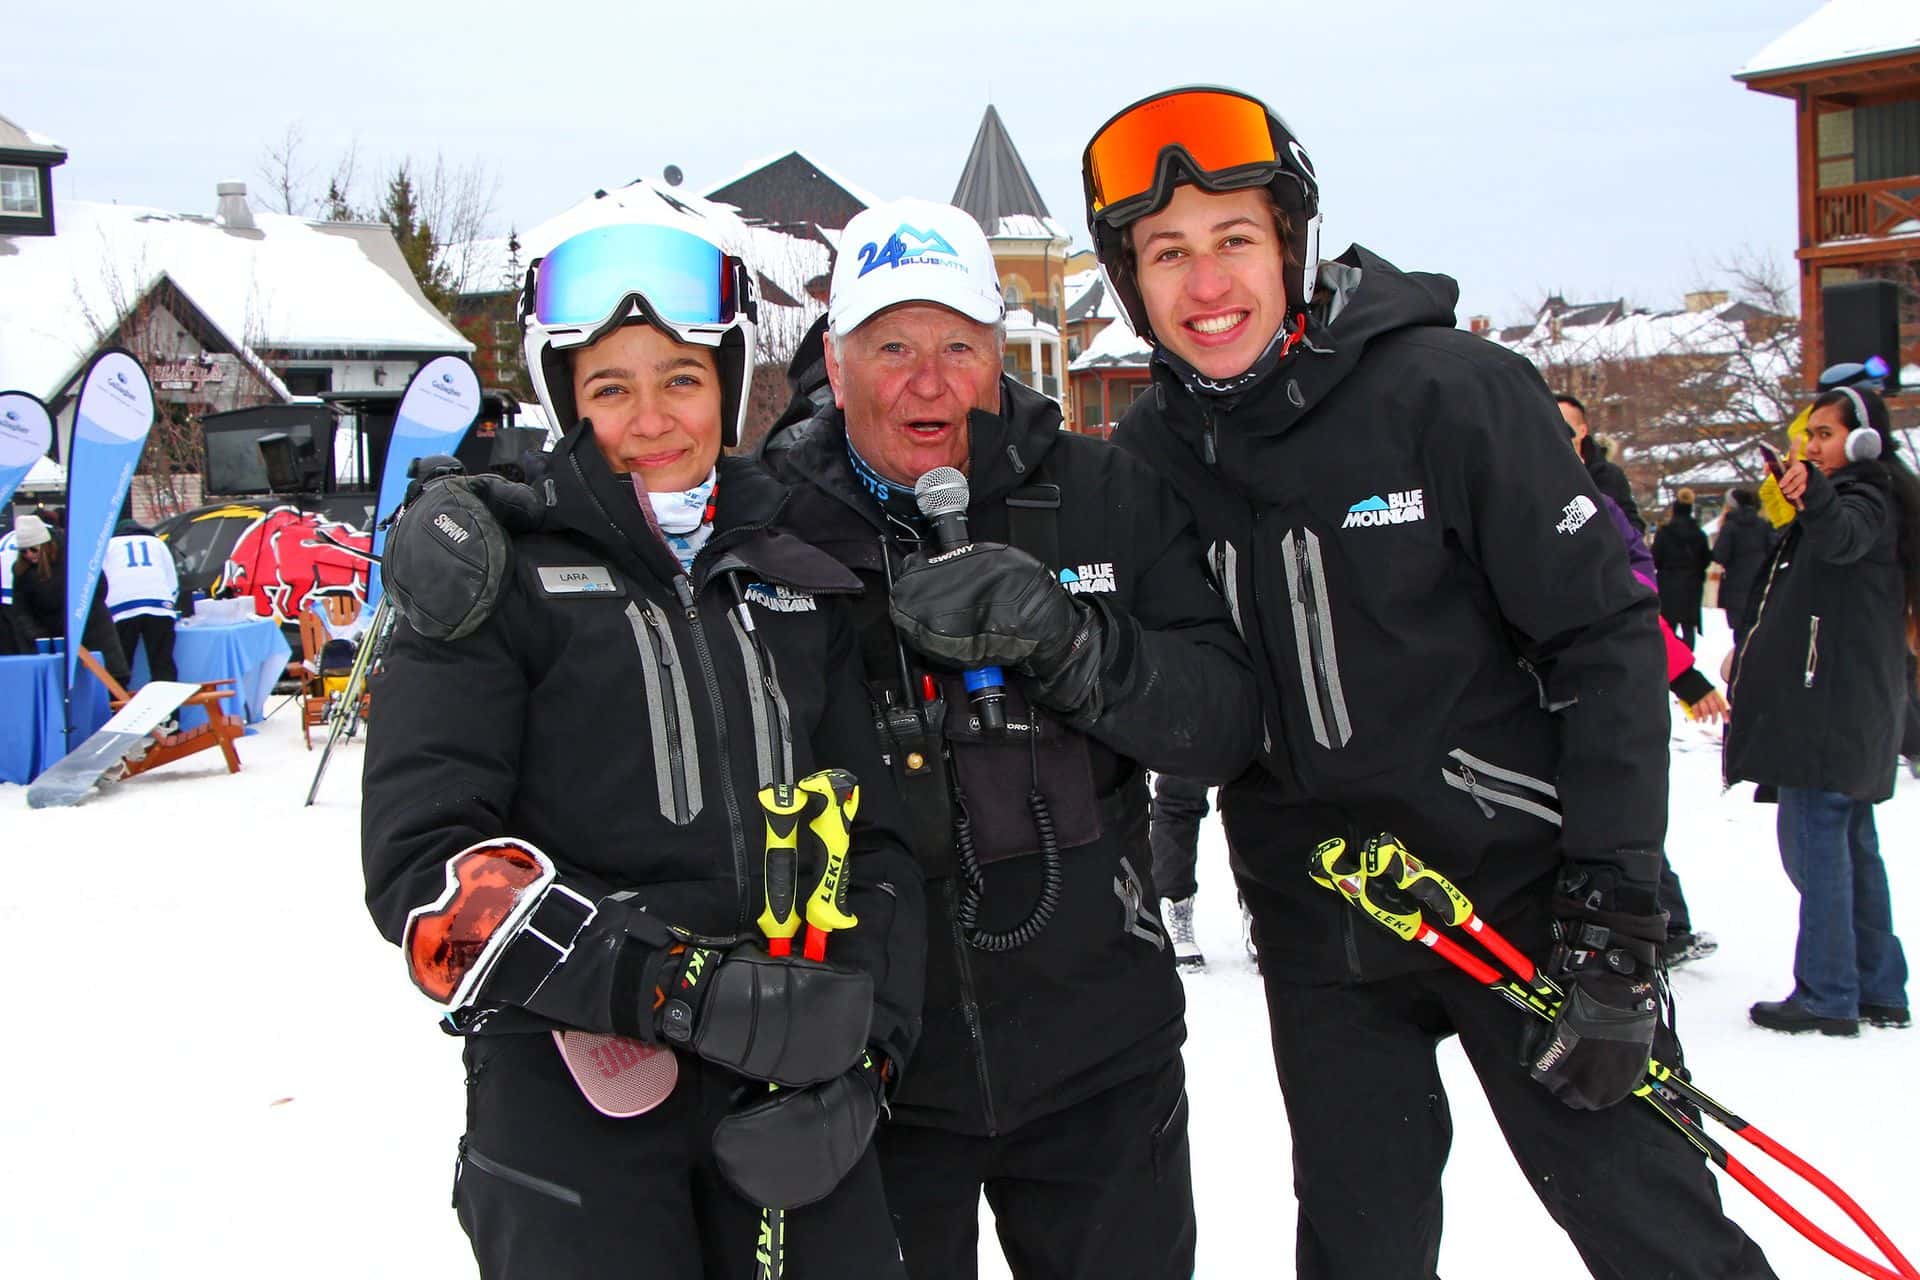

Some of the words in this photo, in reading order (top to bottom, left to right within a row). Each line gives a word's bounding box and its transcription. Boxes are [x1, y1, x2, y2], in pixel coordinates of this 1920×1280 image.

[1387, 489, 1423, 509] BLUE
[433, 513, 470, 544] SWANY
[1340, 504, 1425, 529] MOUNTAIN
[124, 540, 153, 567] 11
[928, 543, 976, 564] SWANY
[560, 573, 590, 582] LARA
[1077, 562, 1114, 580] BLUE
[1368, 838, 1378, 872] LEKI
[820, 854, 842, 905] LEKI
[1440, 879, 1469, 909] LEKI
[1373, 910, 1412, 933] LEKI
[1536, 1037, 1567, 1073] SWANY
